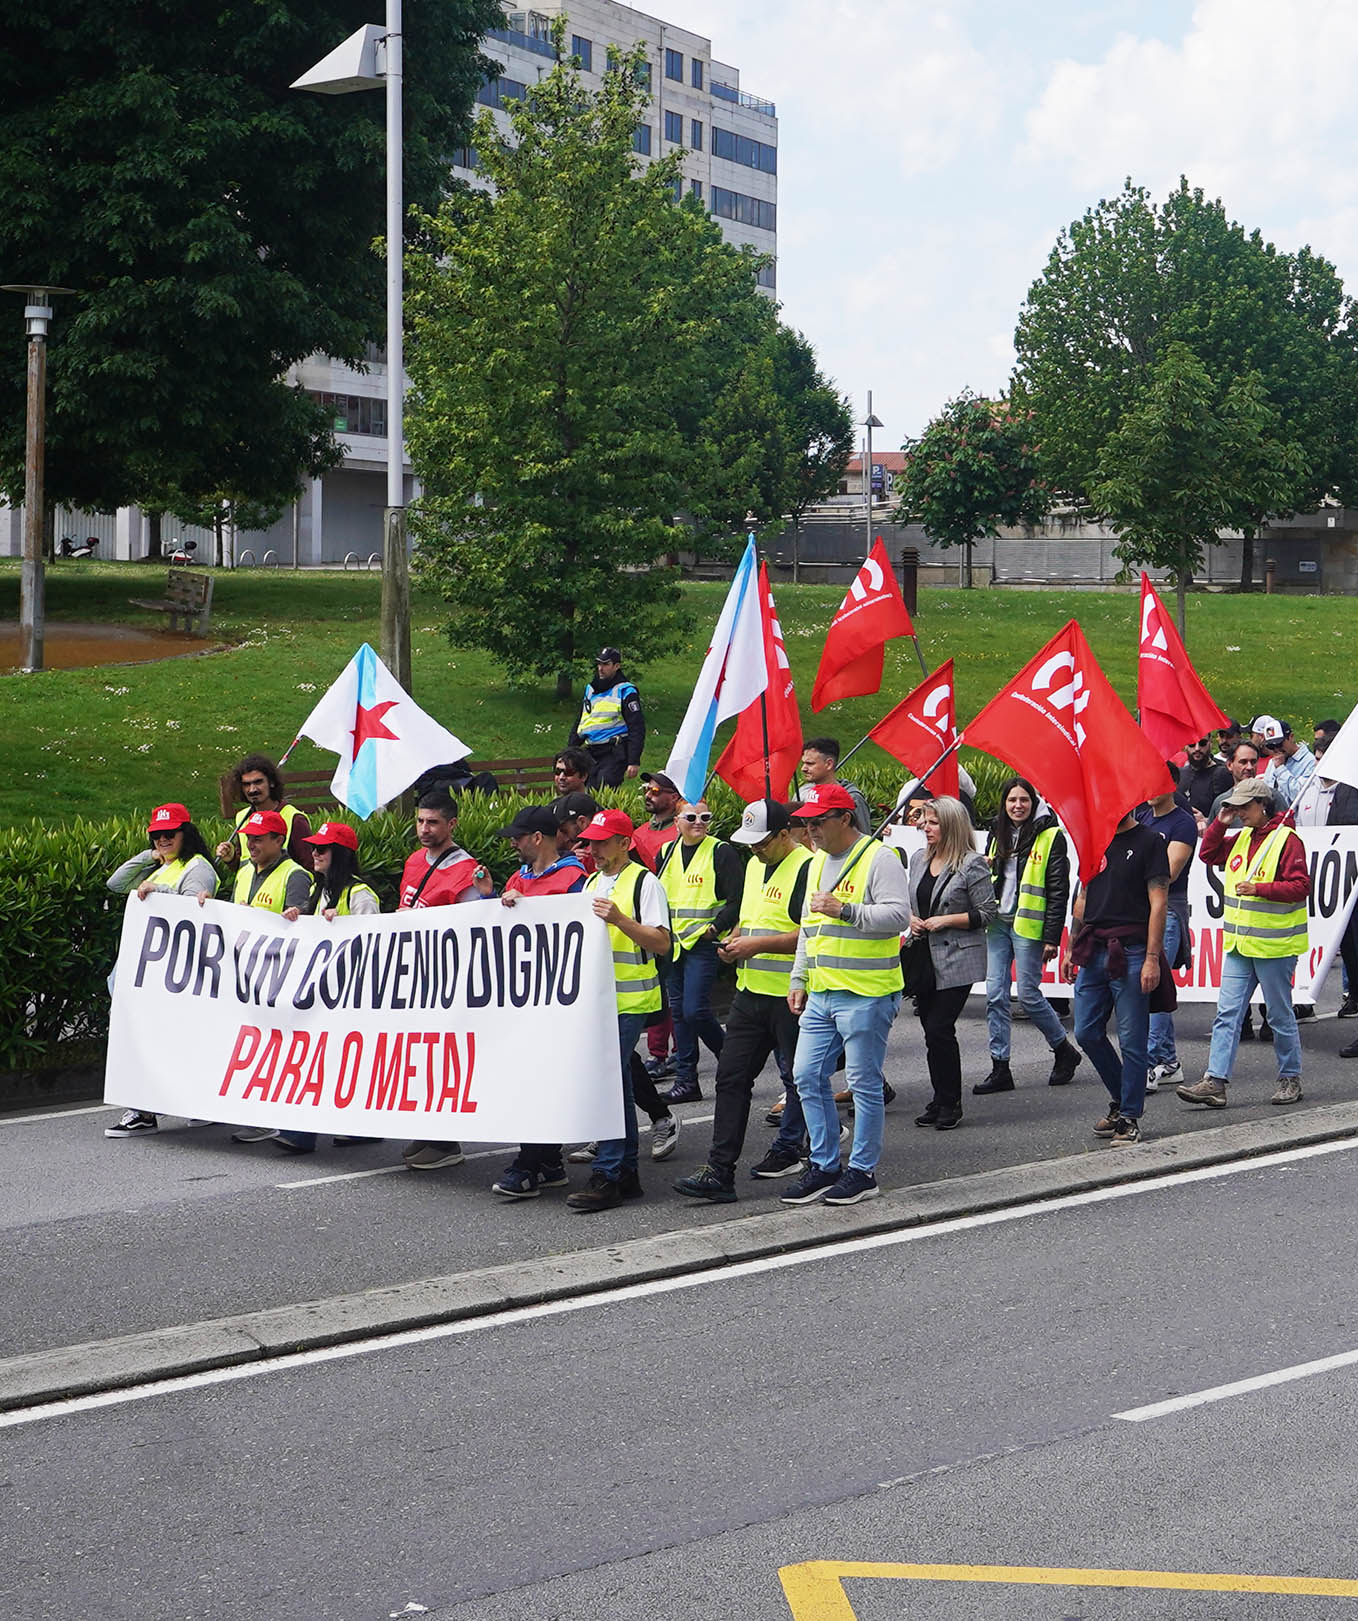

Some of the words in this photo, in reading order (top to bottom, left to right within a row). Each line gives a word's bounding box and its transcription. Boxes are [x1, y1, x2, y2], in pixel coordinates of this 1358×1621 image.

[133, 915, 226, 999] POR
[233, 929, 300, 1009] UN
[292, 928, 460, 1010] CONVENIO
[466, 920, 585, 1009] DIGNO
[218, 1024, 329, 1107] PARA
[333, 1030, 364, 1110] O
[365, 1031, 479, 1114] METAL
